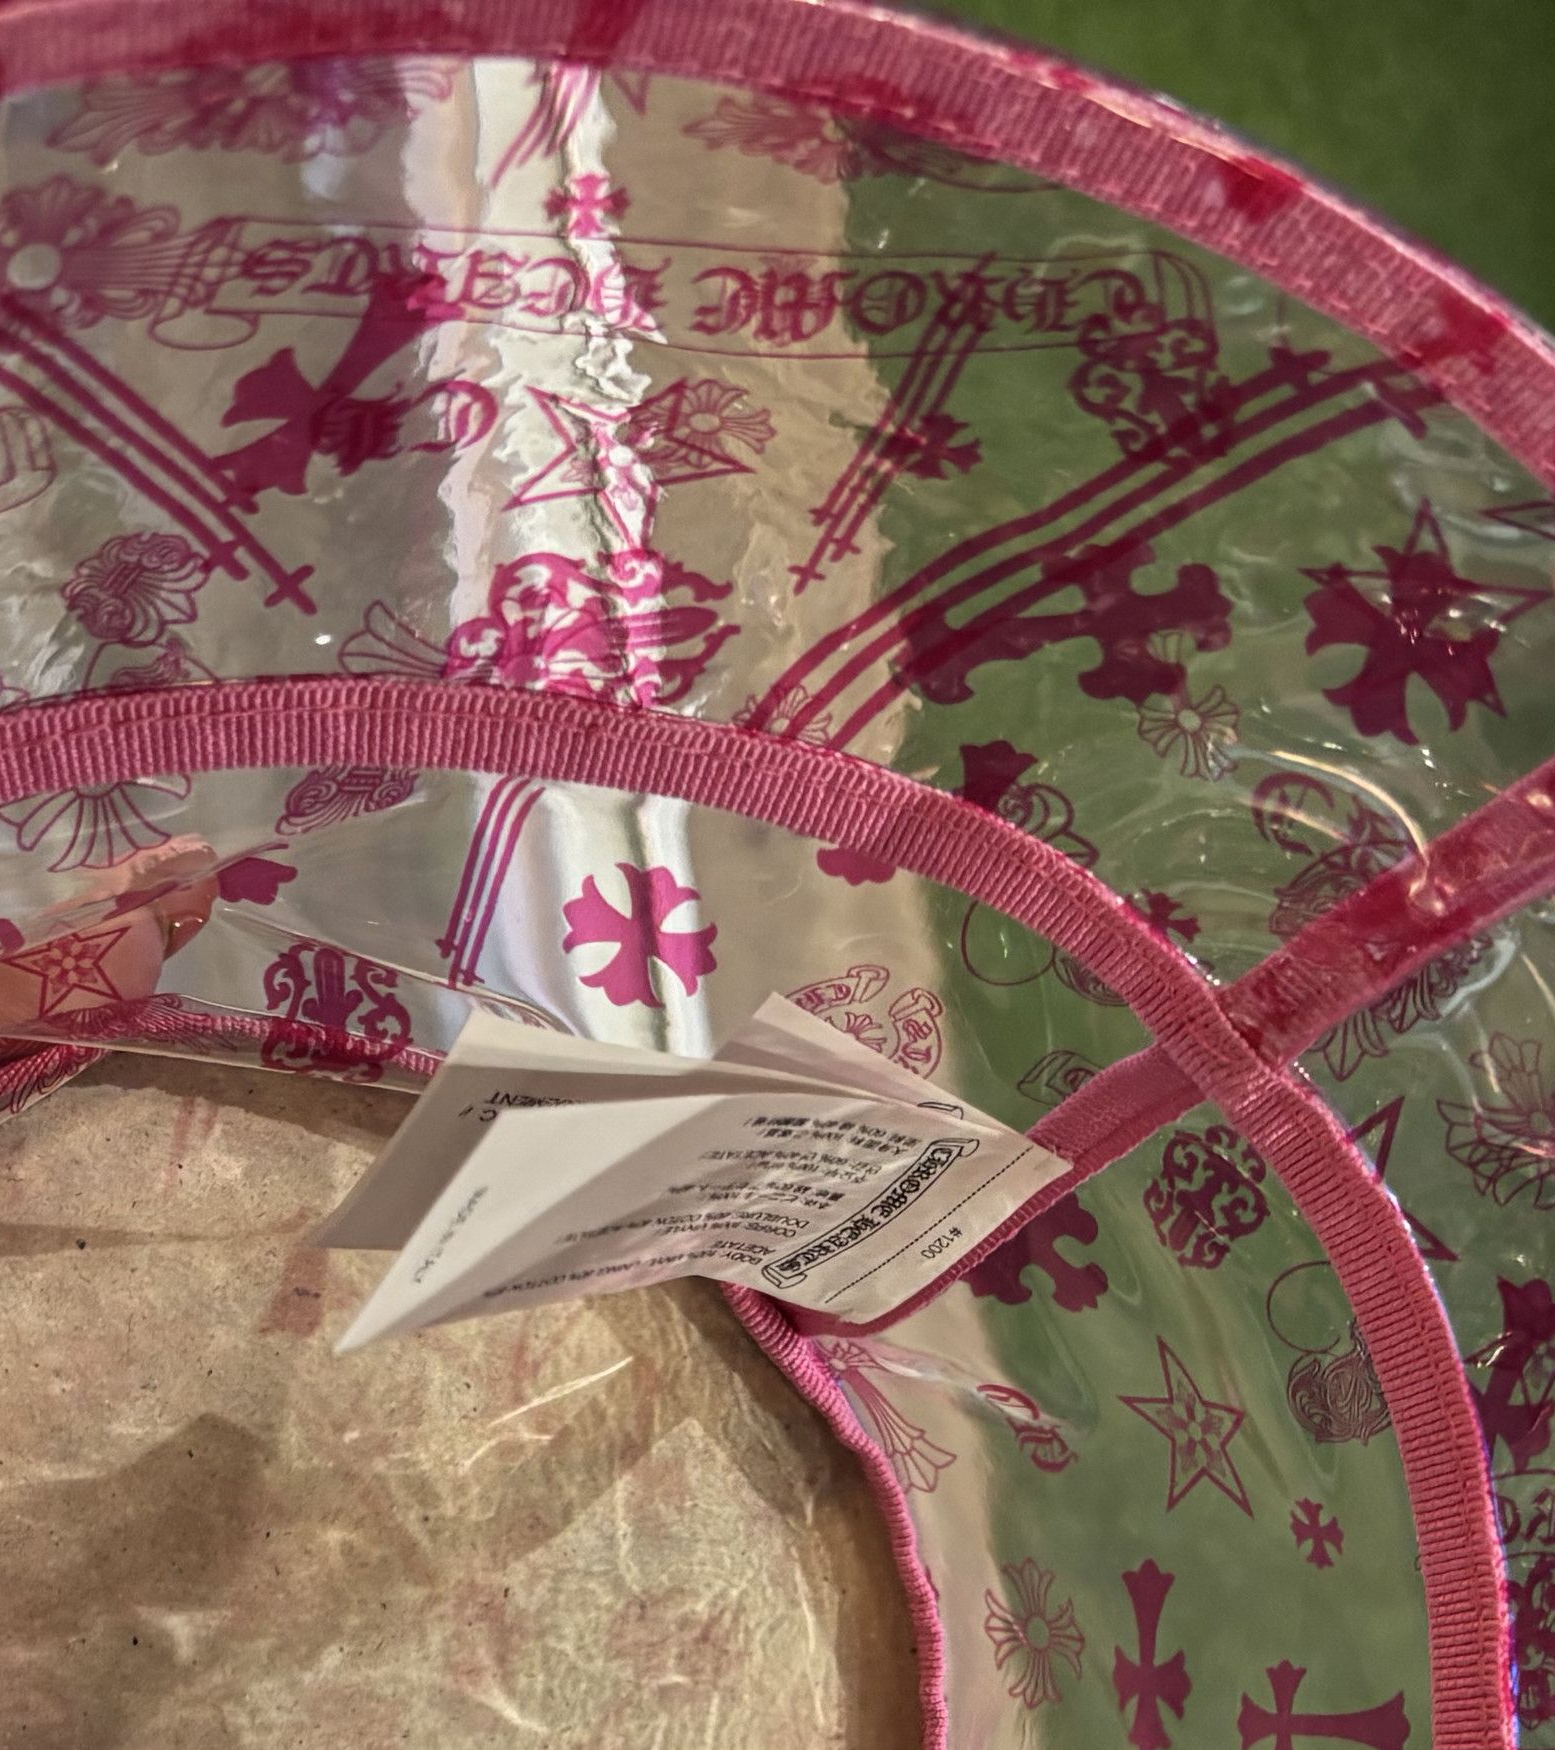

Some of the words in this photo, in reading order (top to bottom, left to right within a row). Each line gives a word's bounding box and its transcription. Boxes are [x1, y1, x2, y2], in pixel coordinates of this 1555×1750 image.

[870, 1146, 954, 1218] CHROME
[774, 1213, 878, 1273] HEARTS
[919, 1225, 964, 1262] #1200
